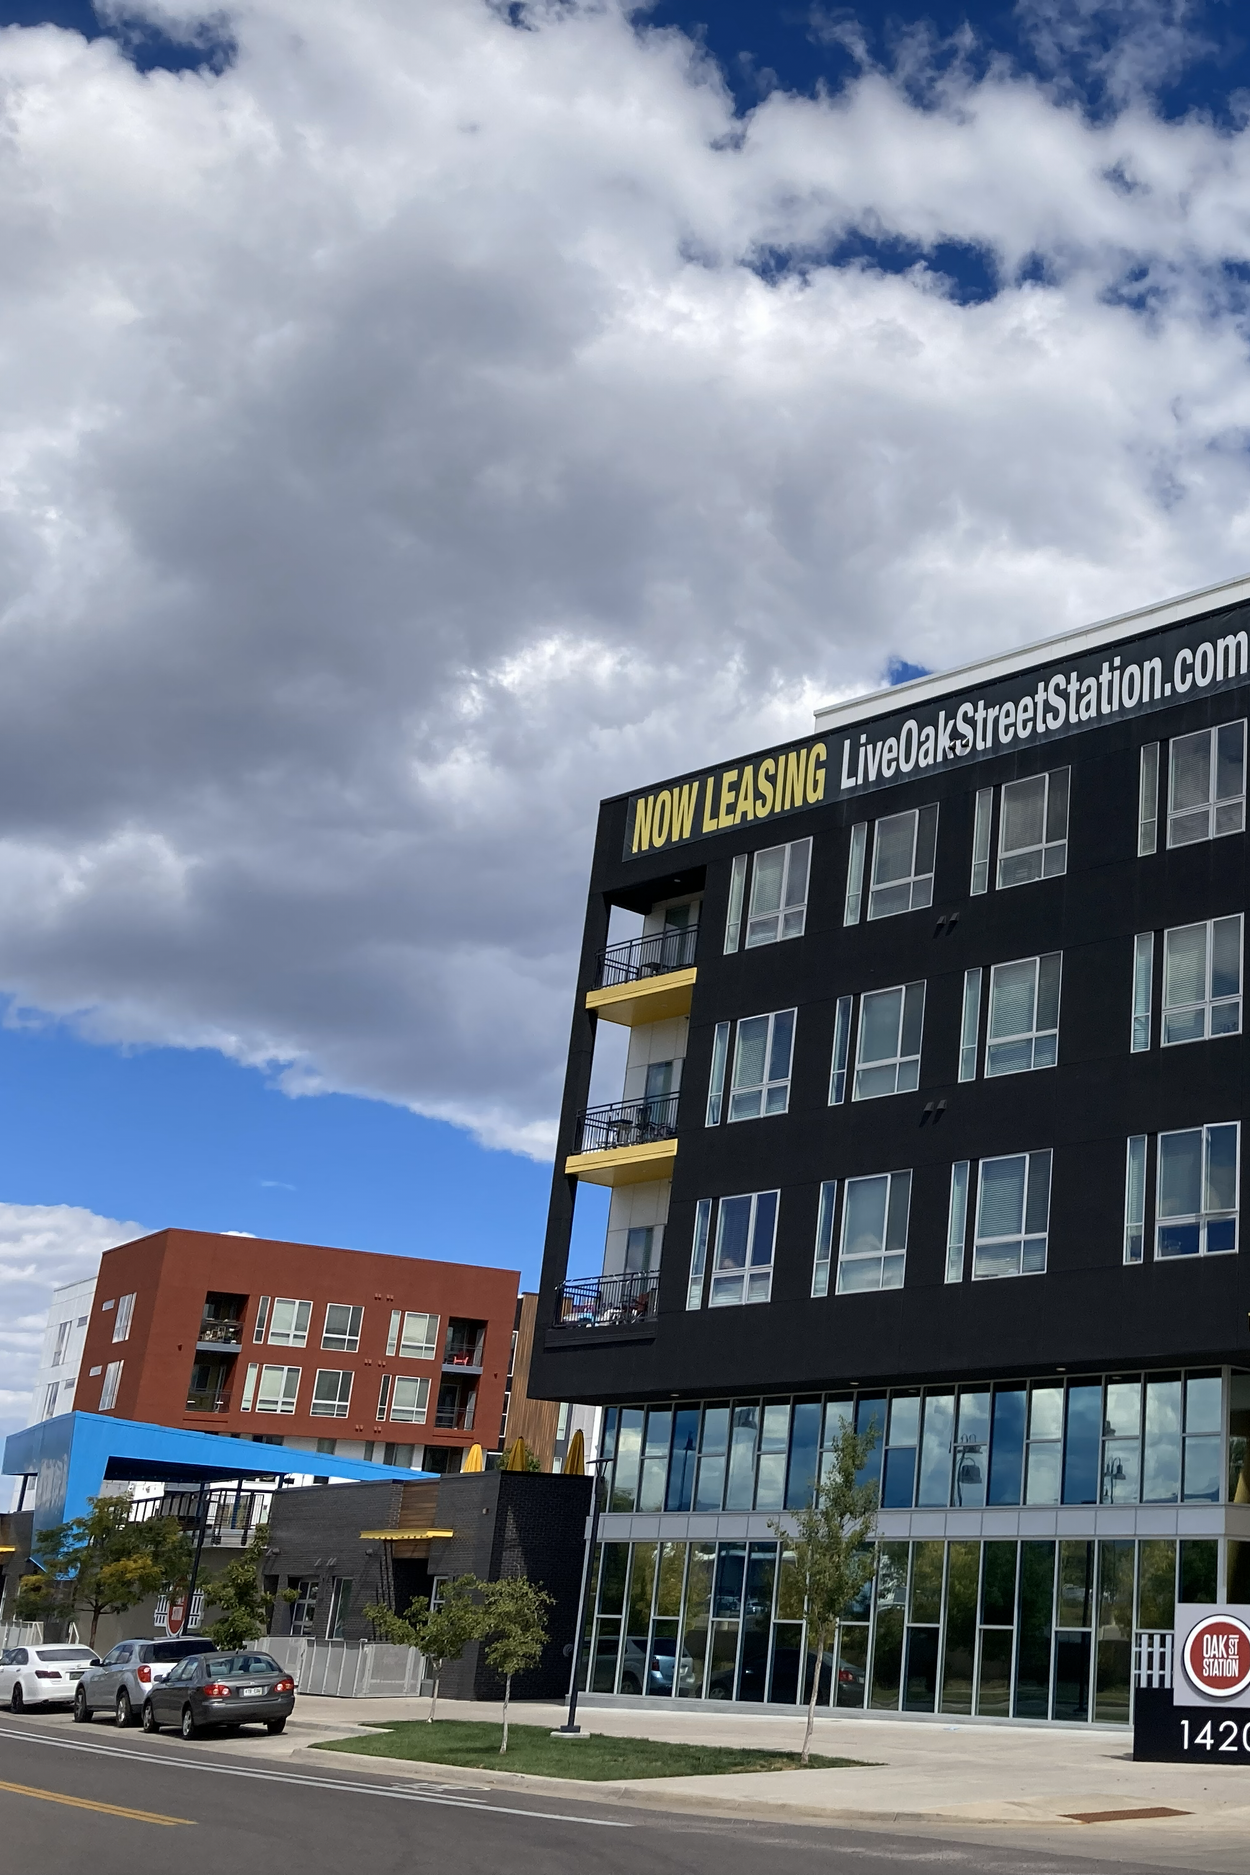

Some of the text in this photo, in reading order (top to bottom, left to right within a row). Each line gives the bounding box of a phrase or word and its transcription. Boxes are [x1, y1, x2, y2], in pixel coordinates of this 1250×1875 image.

[632, 631, 1248, 854] NOW LEASING LiveOakStreetStation.com
[1203, 1634, 1239, 1658] OAK ST
[1203, 1658, 1239, 1677] STATION
